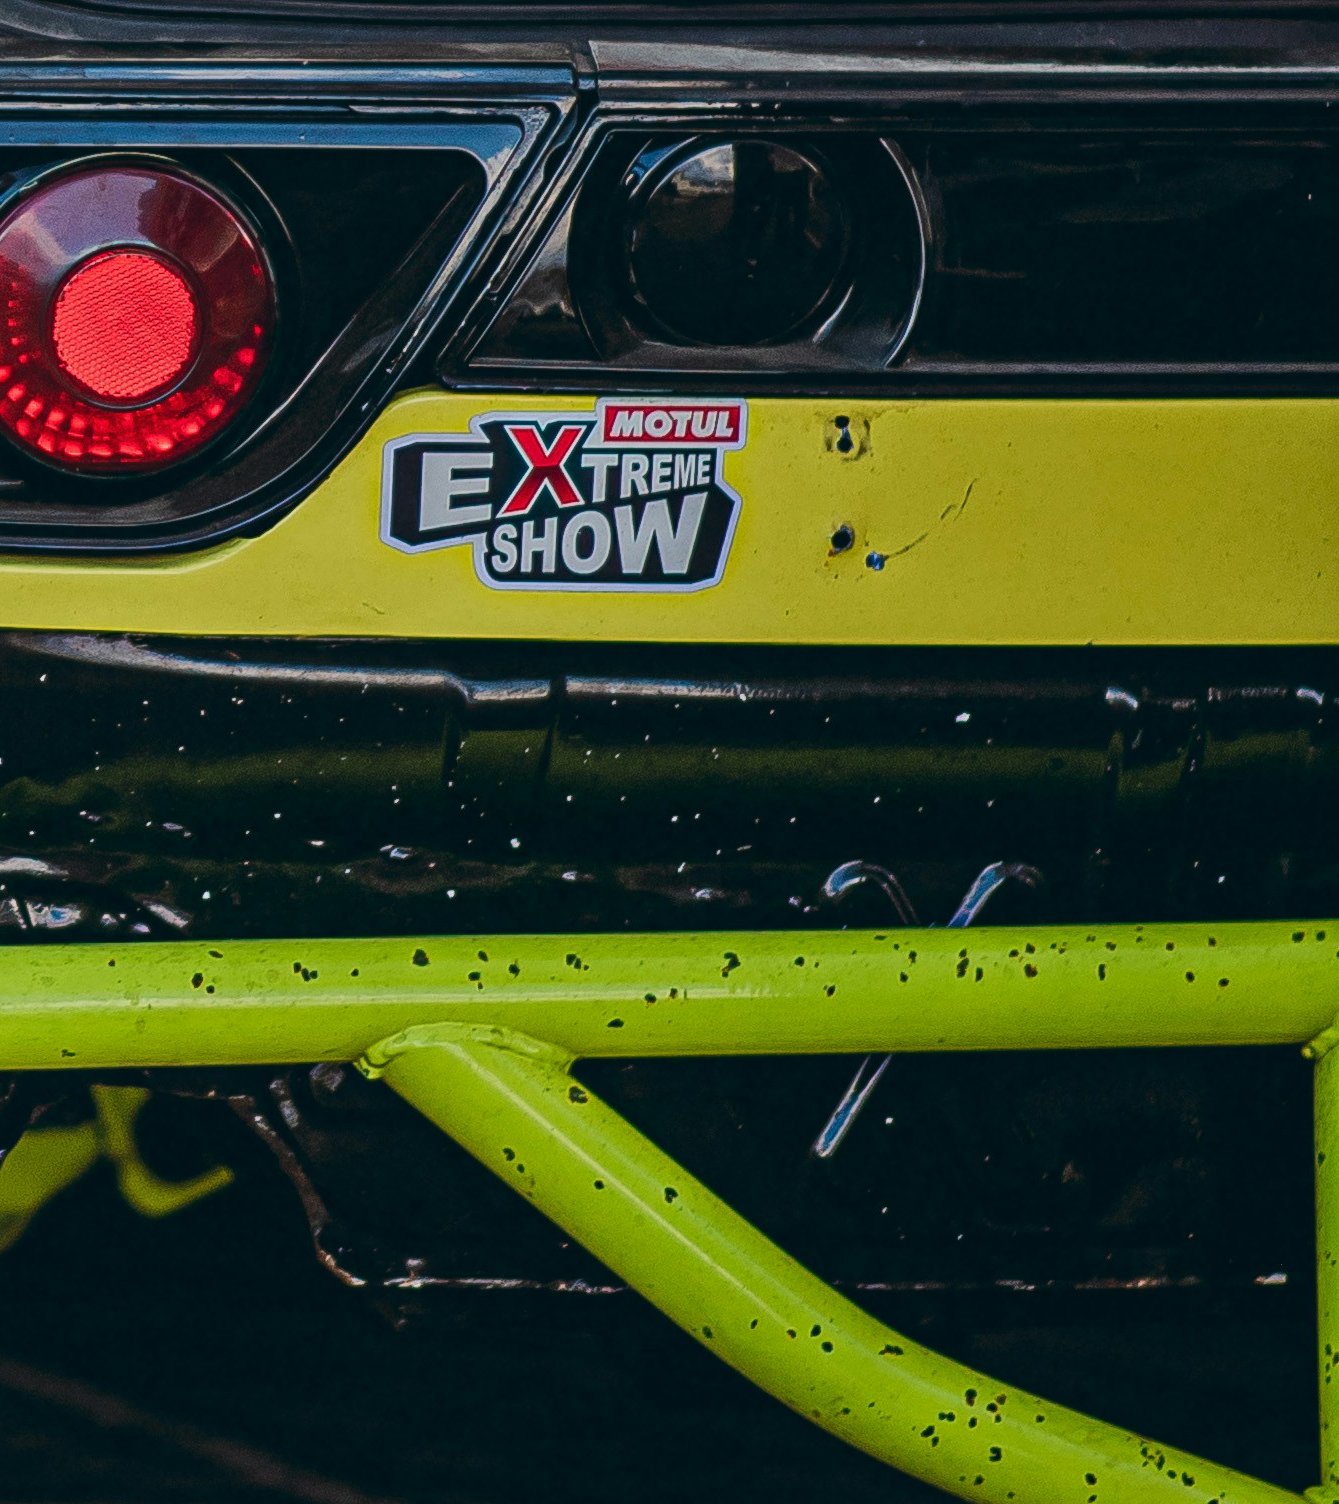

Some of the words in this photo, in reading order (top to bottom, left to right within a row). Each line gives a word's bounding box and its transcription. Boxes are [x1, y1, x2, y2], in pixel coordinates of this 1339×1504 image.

[609, 409, 735, 440] MOTUL
[418, 422, 713, 532] EXTREME
[490, 492, 707, 575] SHOW
